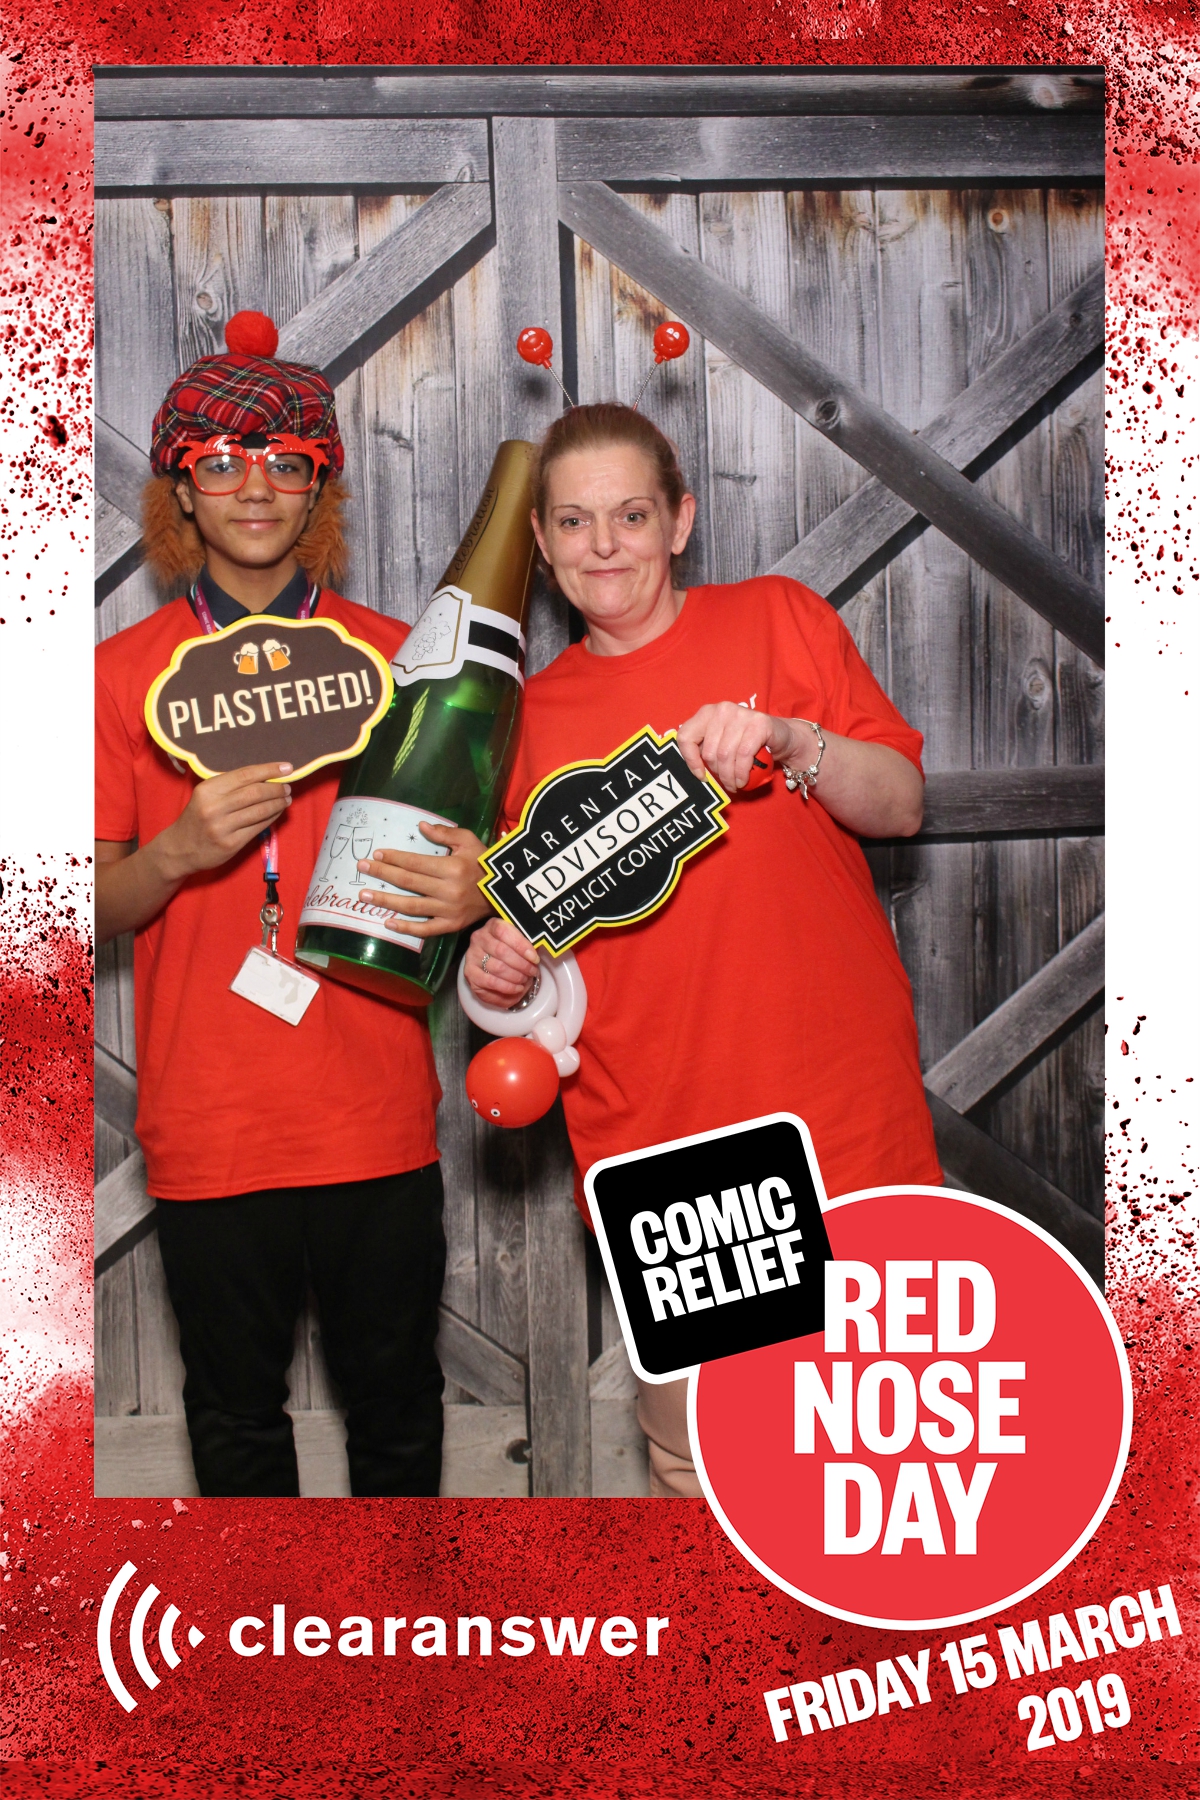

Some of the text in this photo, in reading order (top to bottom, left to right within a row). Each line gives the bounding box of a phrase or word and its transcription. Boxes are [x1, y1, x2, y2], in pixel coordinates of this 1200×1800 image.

[443, 486, 495, 585] Celebration
[168, 670, 374, 738] PLASTERED!
[502, 754, 662, 880] PARENTAL
[525, 774, 680, 908] ADVISORY
[543, 804, 702, 933] EXPLICIT CONTENT
